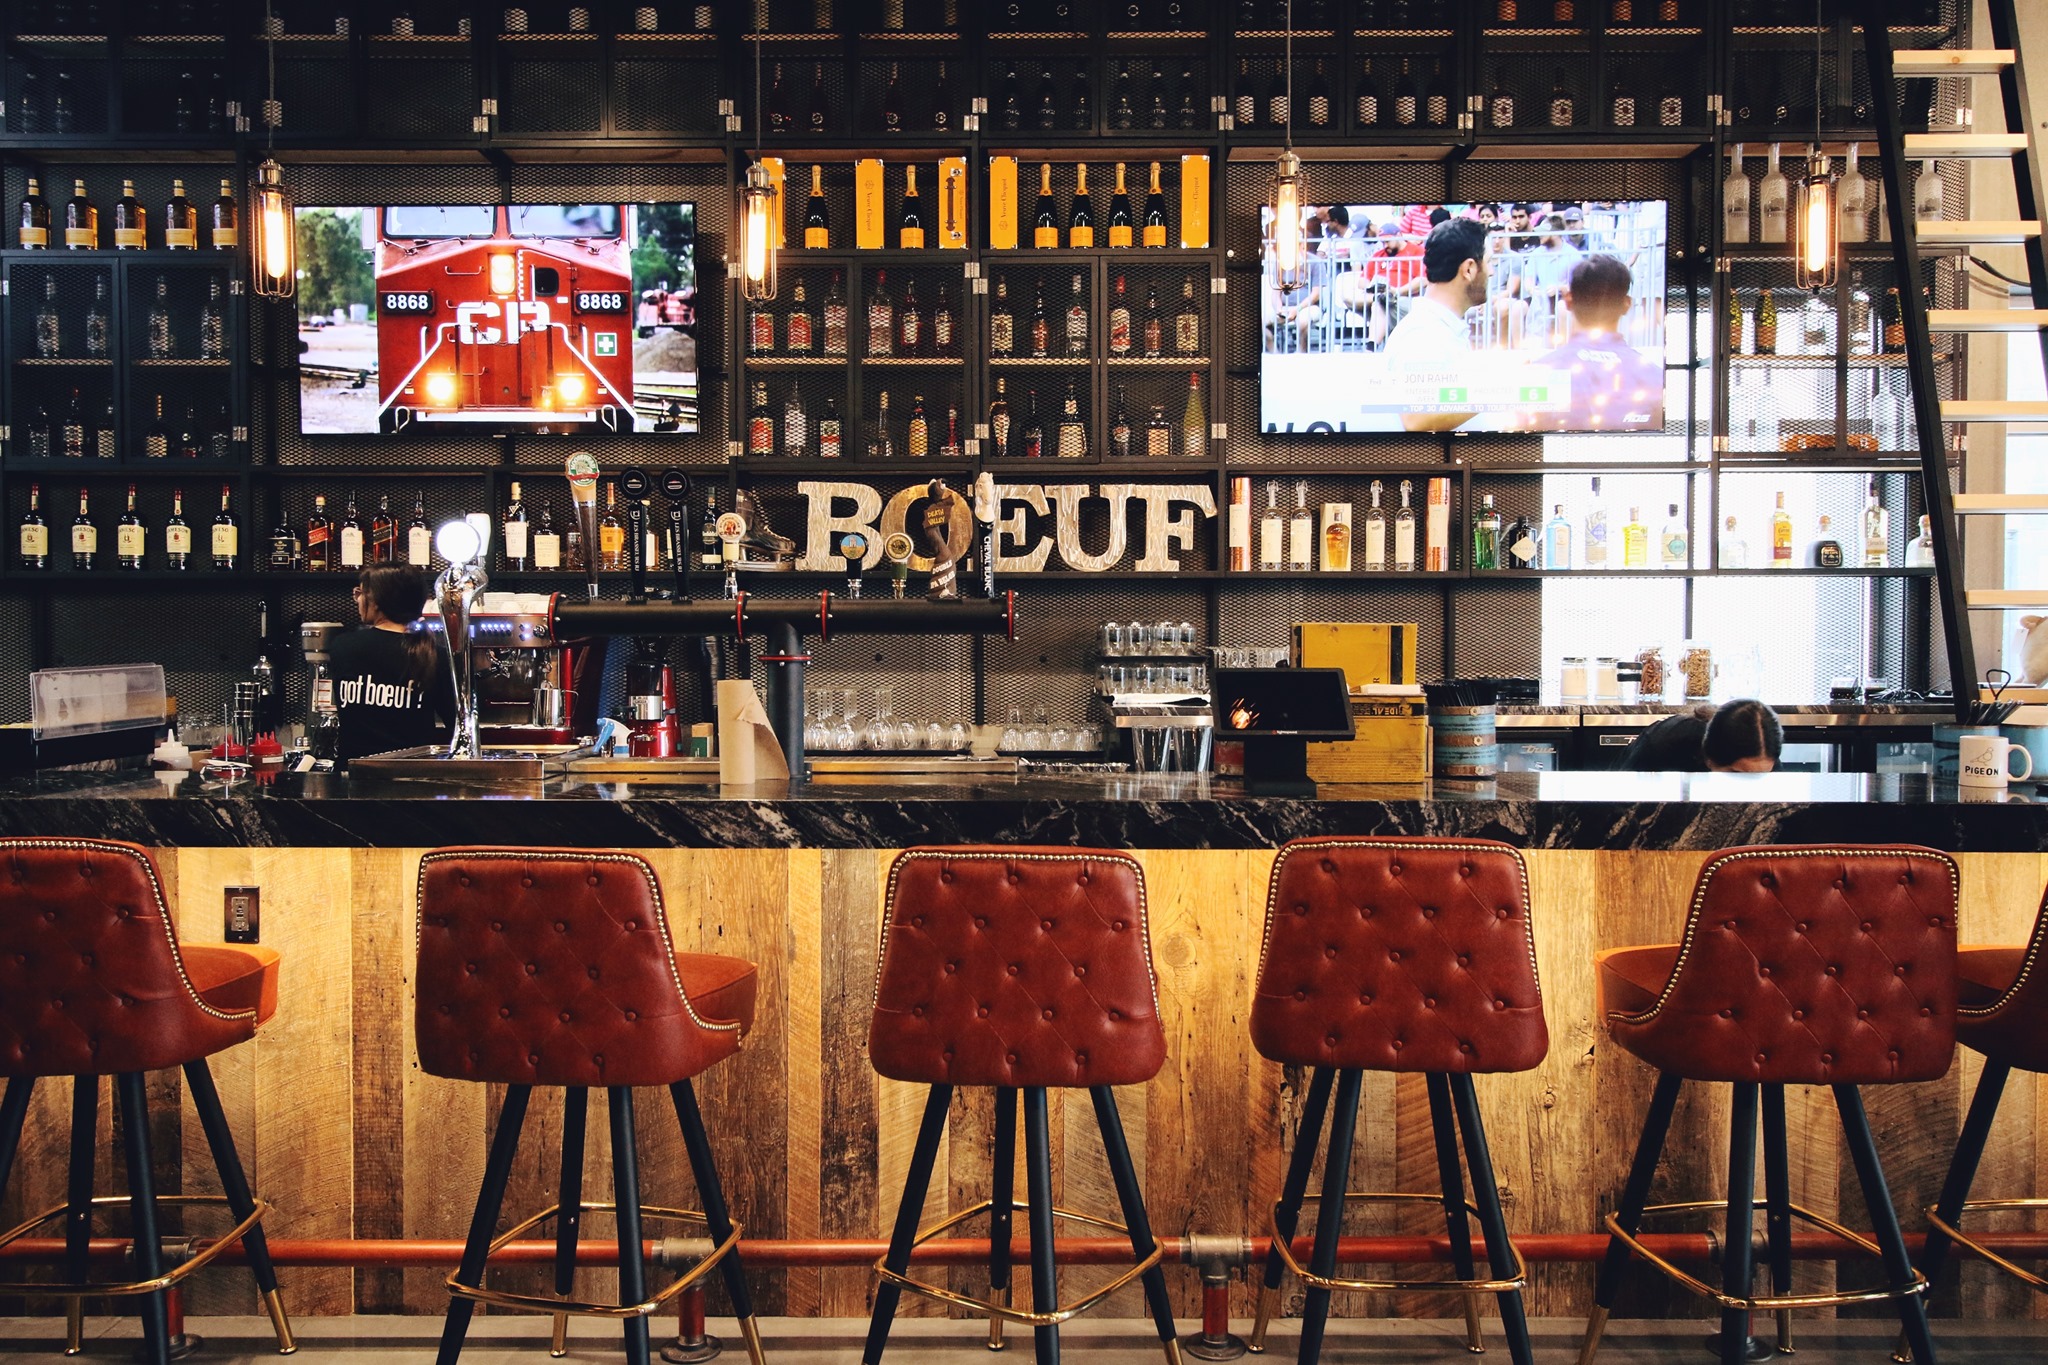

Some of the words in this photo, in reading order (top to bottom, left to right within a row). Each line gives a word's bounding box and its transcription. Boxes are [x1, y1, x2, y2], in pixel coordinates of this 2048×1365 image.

[387, 294, 428, 309] 8868
[580, 293, 622, 309] 8868
[457, 301, 550, 344] CP
[1404, 374, 1425, 383] JON
[1427, 374, 1459, 383] RAHM
[1448, 389, 1457, 401] 5
[1529, 389, 1538, 400] 6
[1410, 404, 1424, 412] TOP
[1426, 404, 1437, 412] 30
[1439, 404, 1472, 412] ADVANCE
[1474, 404, 1484, 412] TO
[927, 508, 944, 518] DEATH
[928, 515, 945, 526] VALLEY
[983, 535, 992, 565] CHEVAL
[983, 566, 992, 591] BLANC
[340, 675, 364, 708] got
